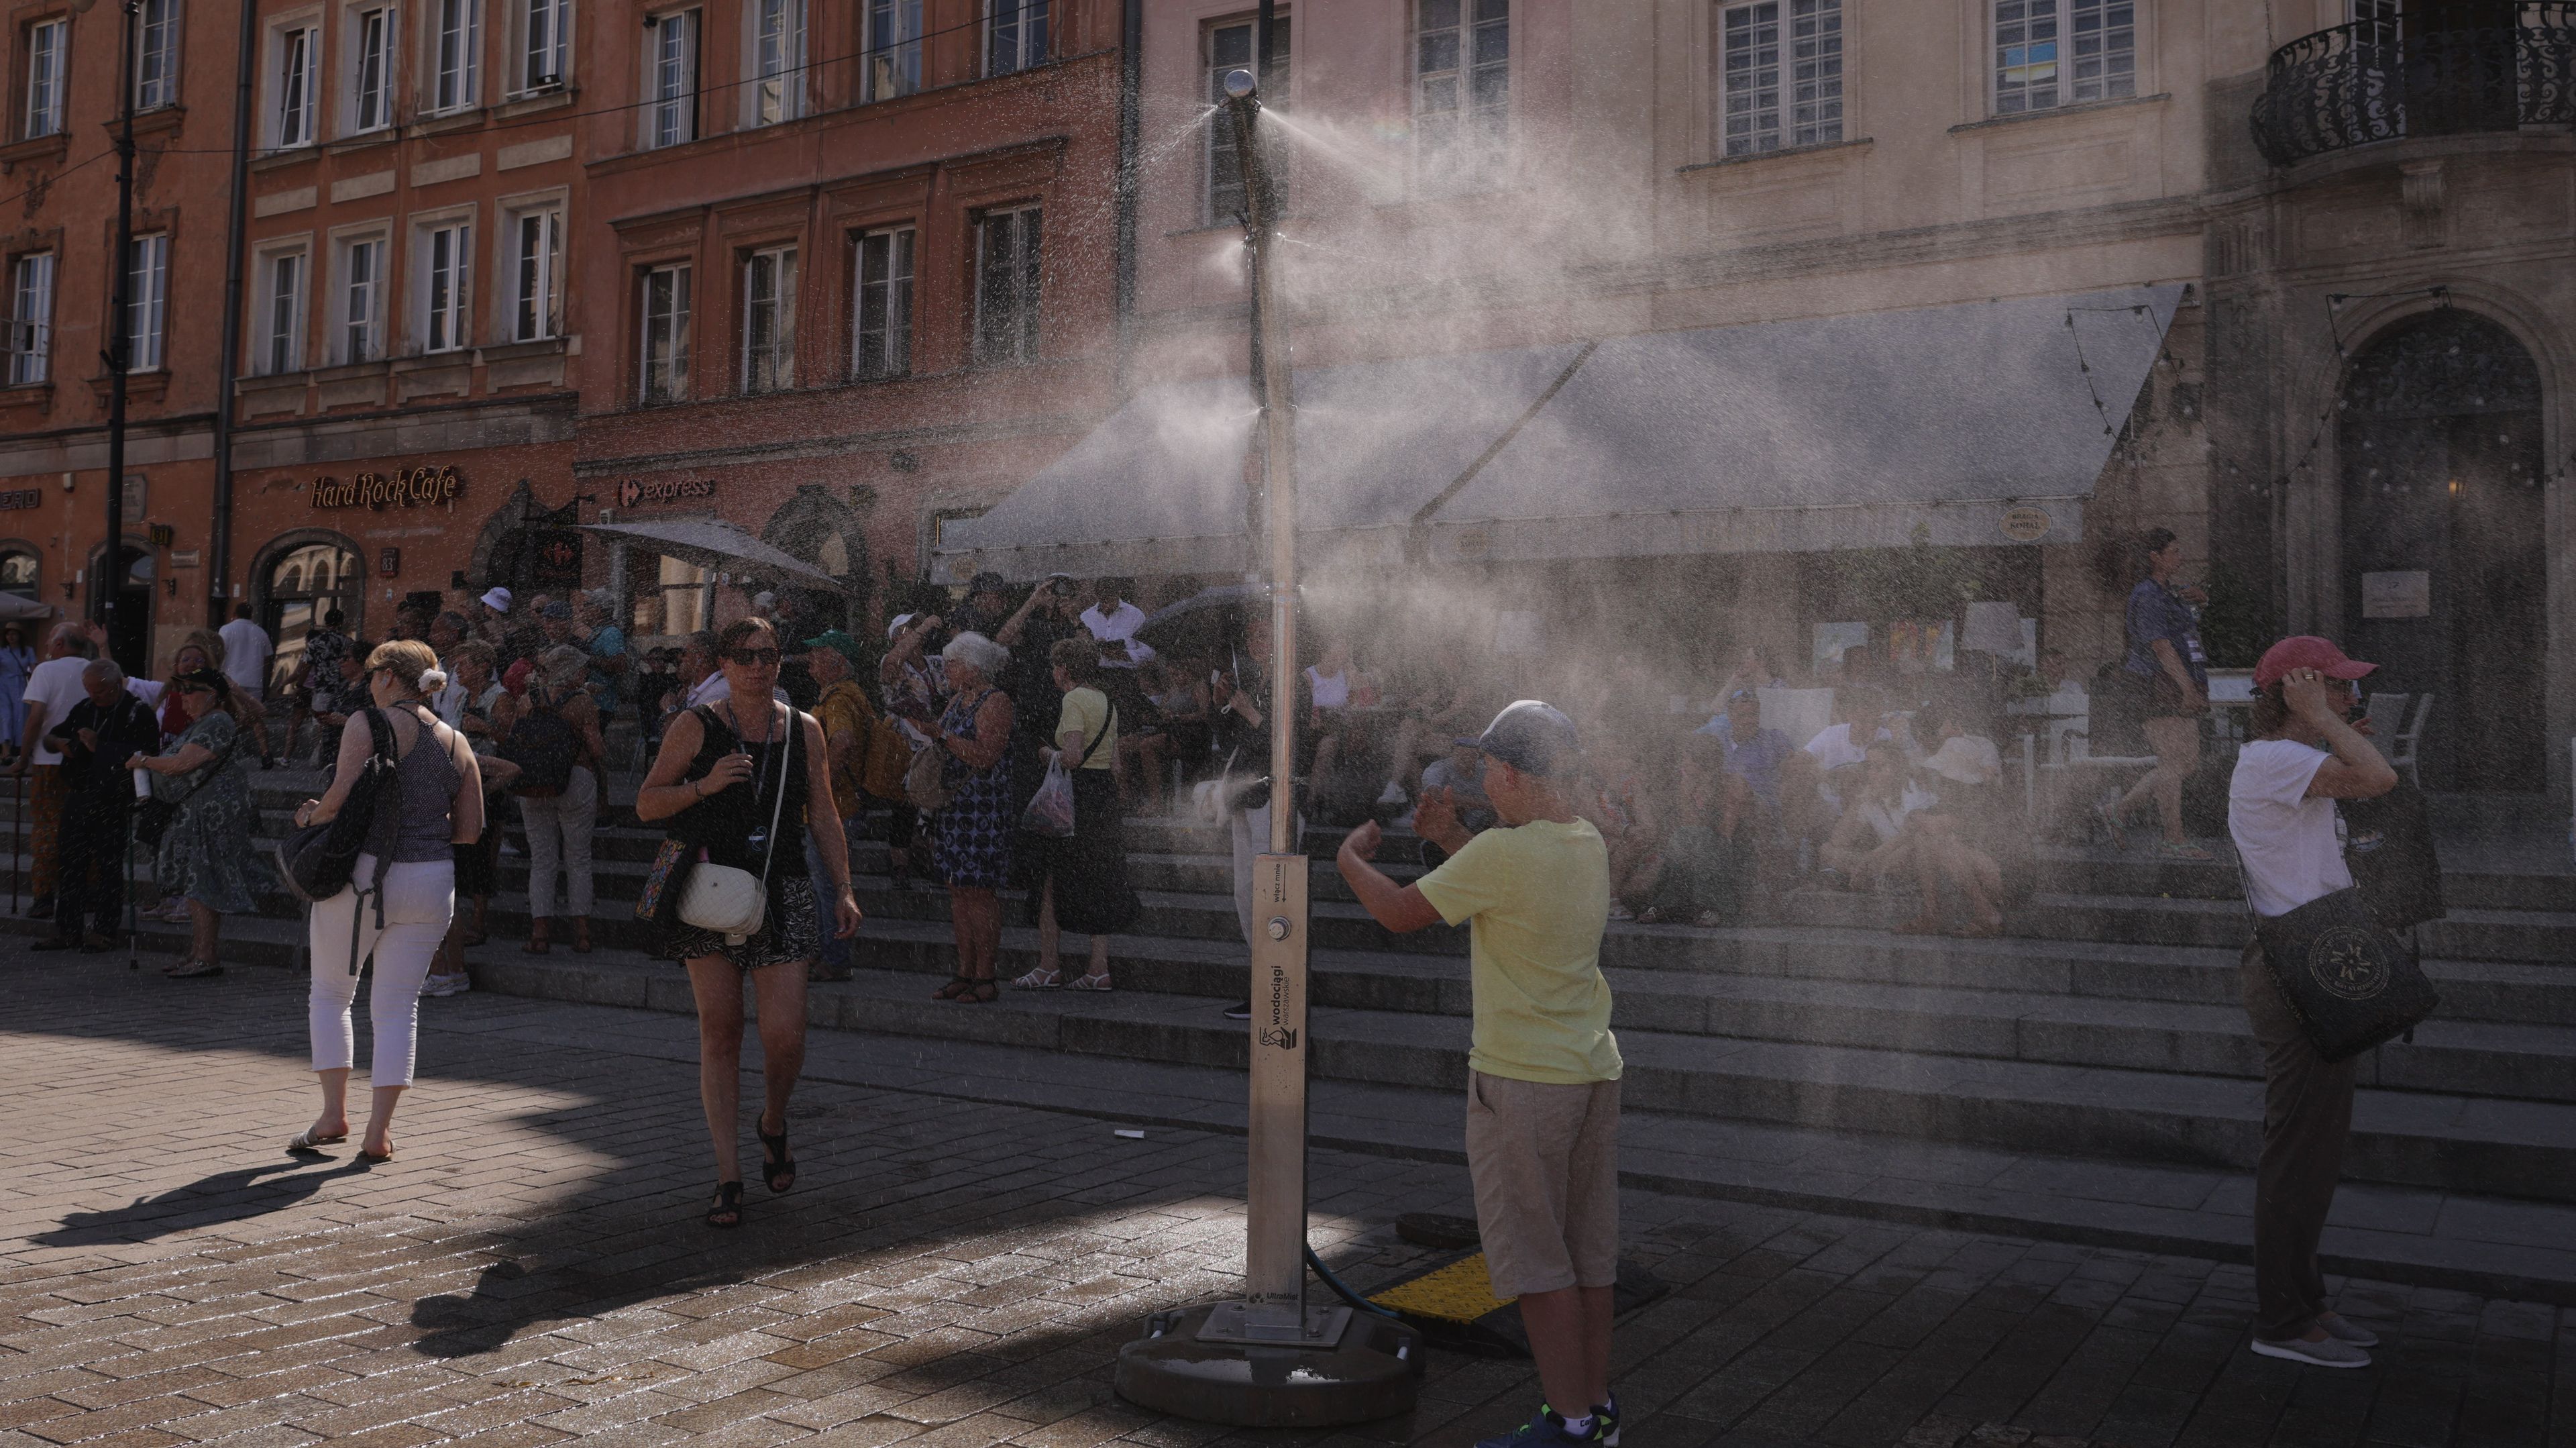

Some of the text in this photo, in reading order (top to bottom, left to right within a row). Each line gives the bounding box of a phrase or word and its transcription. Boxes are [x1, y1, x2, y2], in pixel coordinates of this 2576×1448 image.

[310, 465, 457, 510] Hard Rock Cafe
[644, 479, 710, 503] express
[382, 558, 393, 571] 83
[1273, 864, 1282, 902] włącz mnie
[1271, 966, 1283, 1025] wodociągi
[1267, 1292, 1299, 1300] UltraMist
